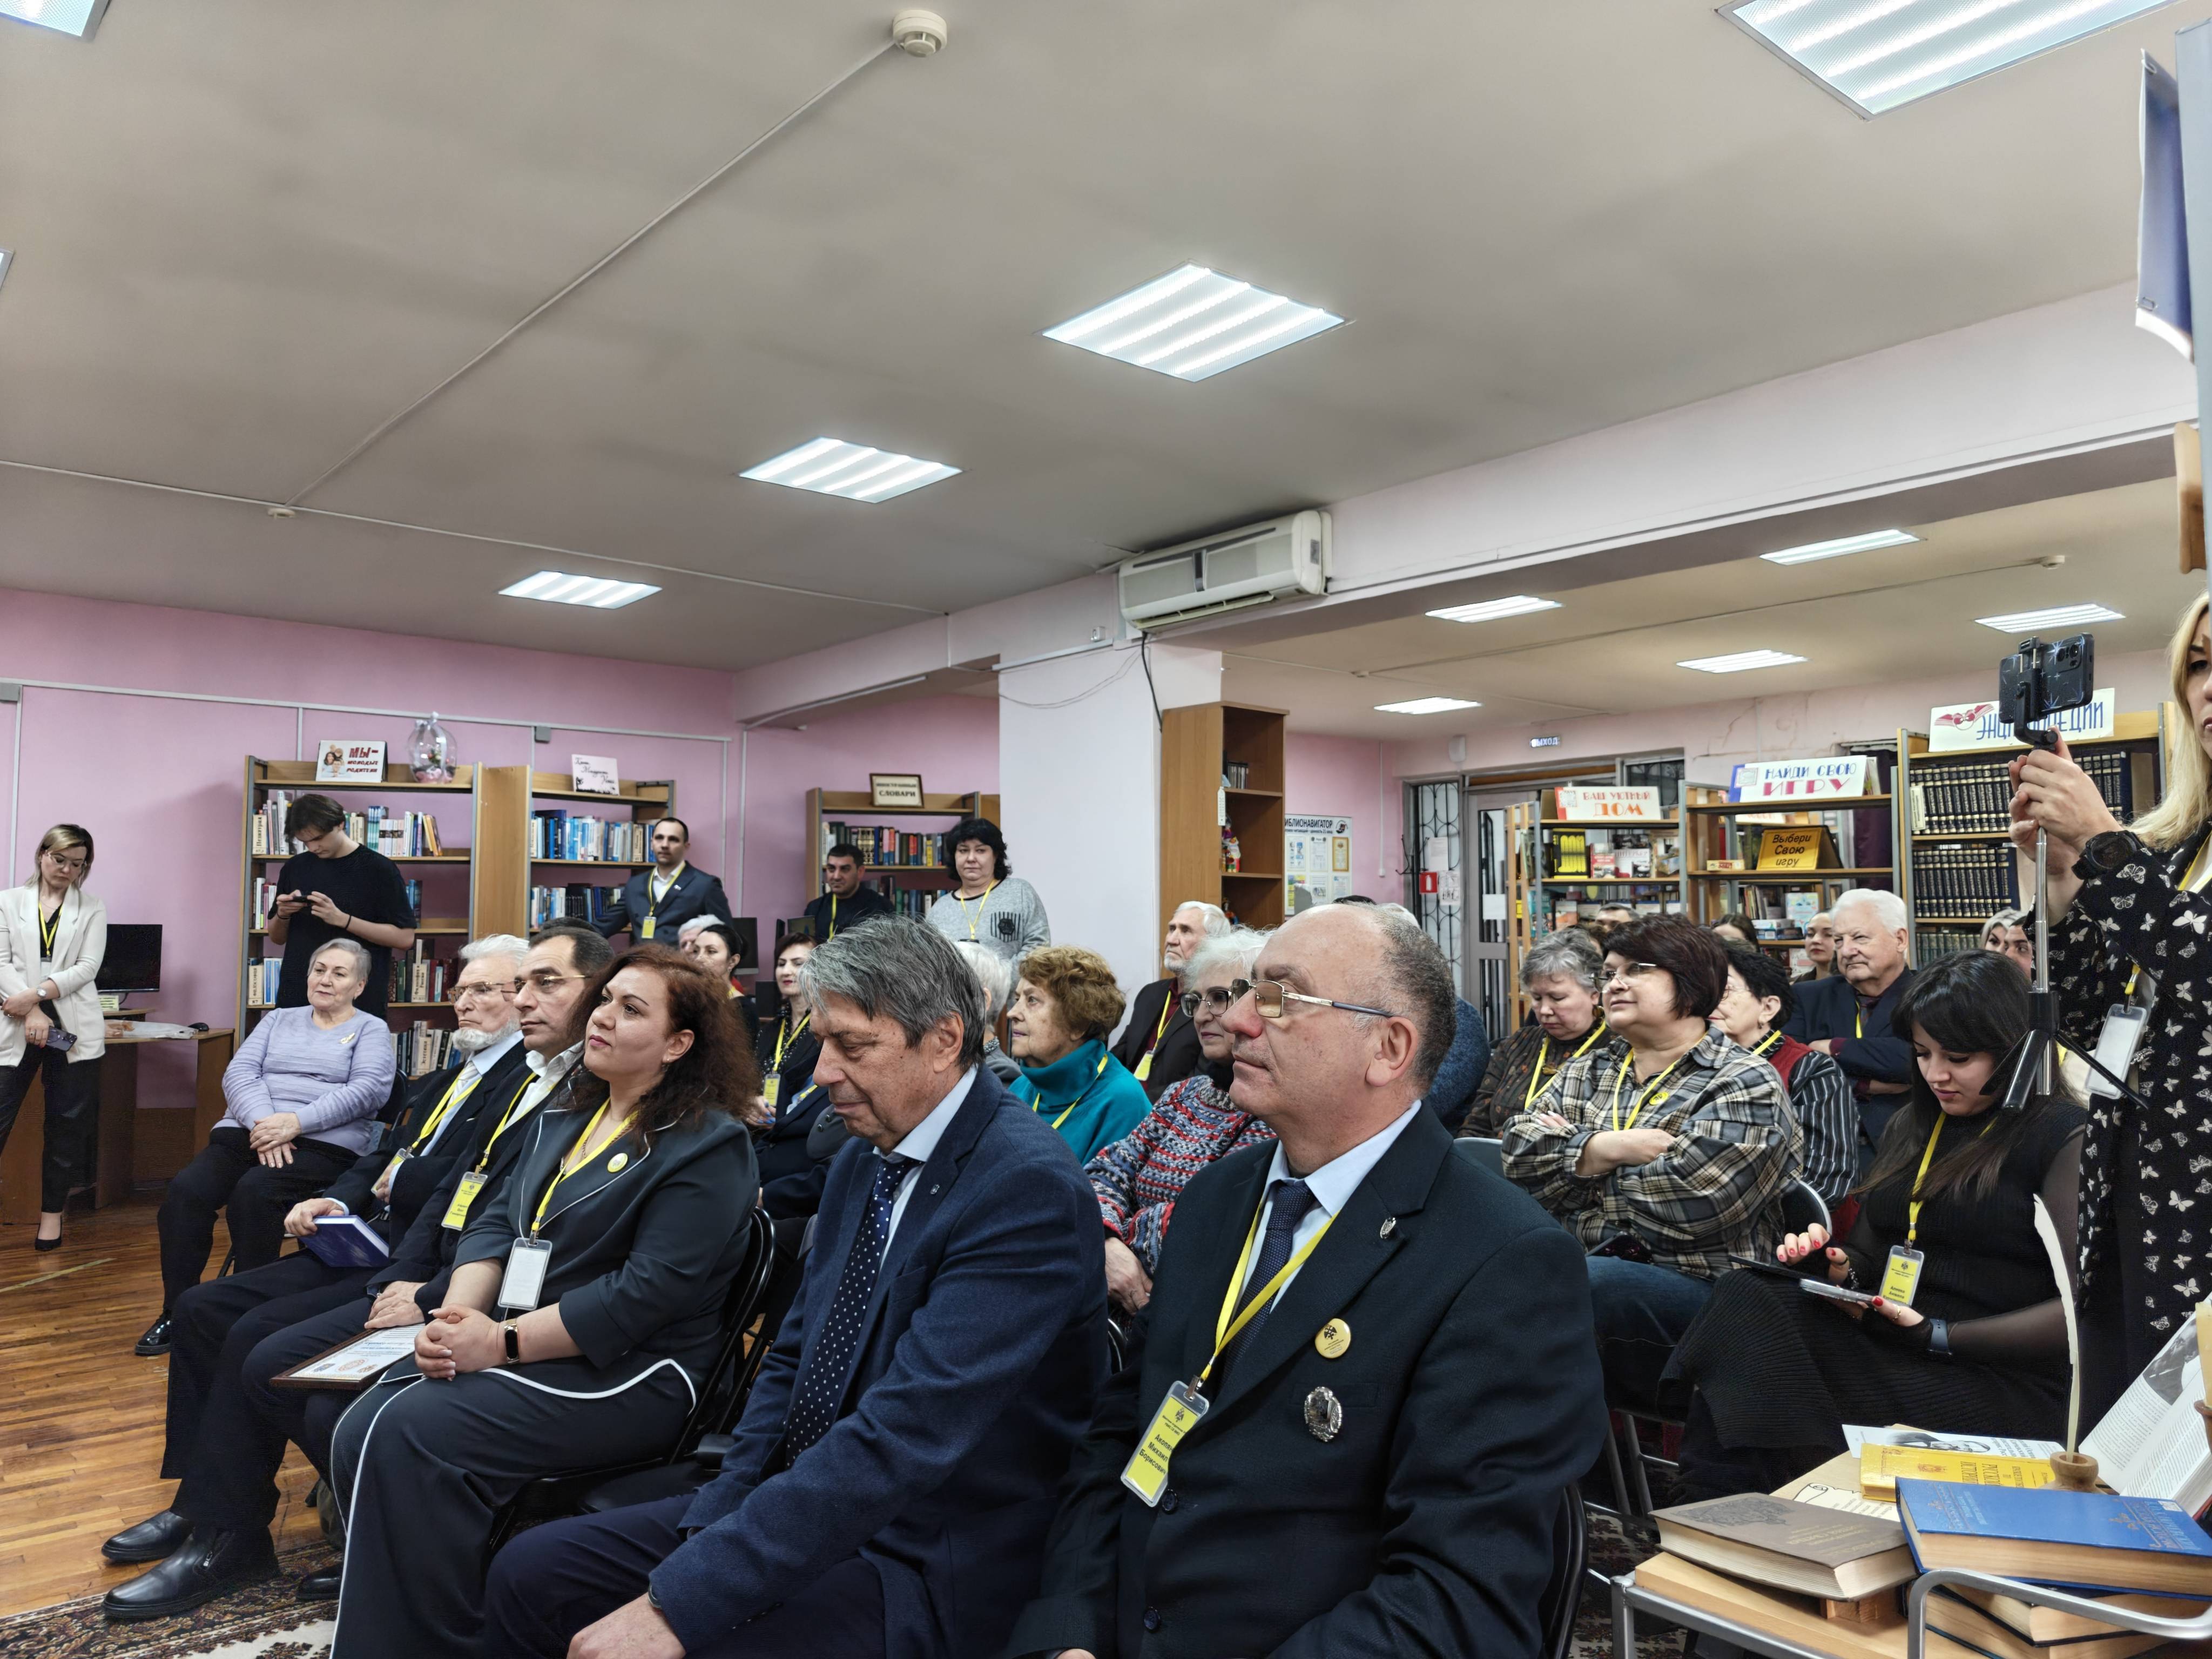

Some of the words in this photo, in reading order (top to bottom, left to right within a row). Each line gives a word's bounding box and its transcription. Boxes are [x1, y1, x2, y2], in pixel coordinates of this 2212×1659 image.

[1976, 702, 2103, 739] ЭНЦПЕДИИ
[1531, 737, 1557, 747] ЫХОД
[1765, 765, 1809, 779] НАЙДИ
[1817, 763, 1857, 776] СВОЮ
[1763, 778, 1850, 796] ИГРУ
[1583, 792, 1606, 800] ВАШ
[1610, 791, 1650, 800] УЮТНЫЙ
[1594, 802, 1643, 816] ДОМ
[1285, 818, 1333, 828] ИБЛИОНАВИГАТОР
[1772, 833, 1811, 843] Выбери
[1775, 845, 1805, 855] Свою
[1776, 858, 1799, 867] игру
[1155, 1434, 1175, 1452] Акопян
[1148, 1442, 1168, 1461] Михаил
[1139, 1449, 1166, 1474] Борисович
